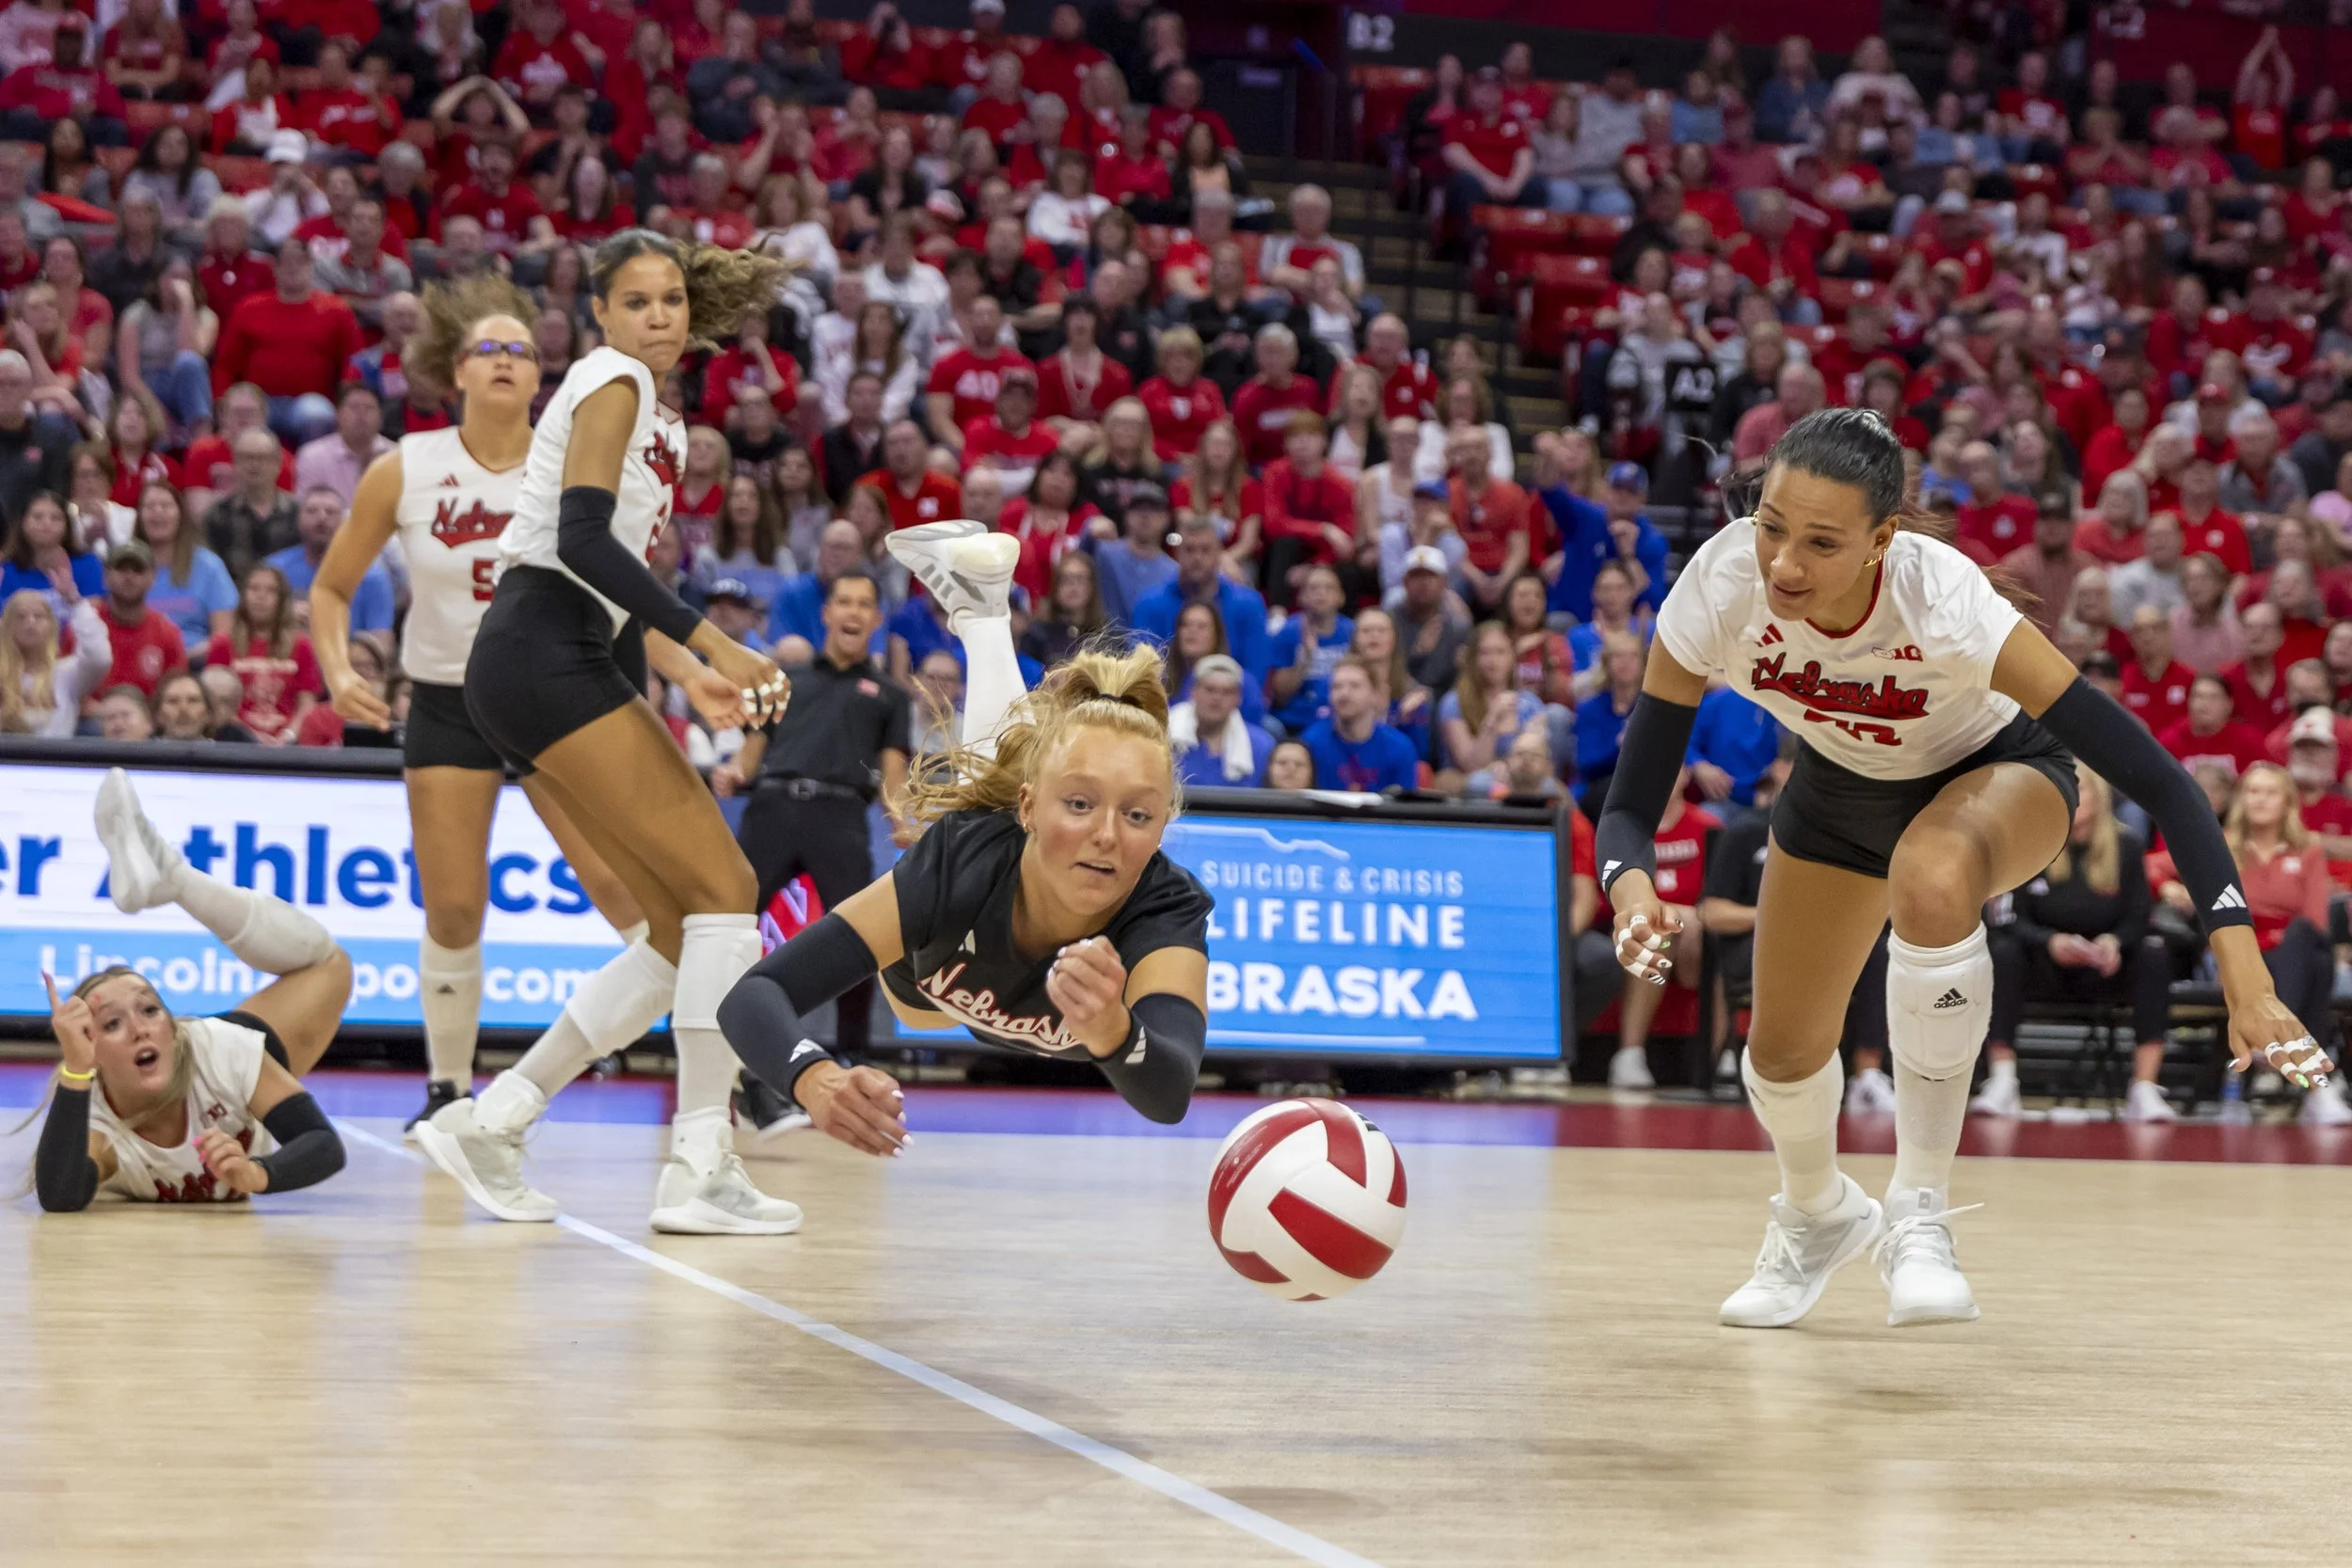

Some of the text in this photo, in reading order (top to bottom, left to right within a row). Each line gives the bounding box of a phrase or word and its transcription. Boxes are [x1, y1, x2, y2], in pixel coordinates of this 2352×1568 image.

[1348, 11, 1394, 51] B2
[1673, 367, 1714, 402] A2
[1752, 652, 1929, 719] Nebraska
[0, 821, 593, 913] r thlecs
[1200, 860, 1464, 897] SUICIDE & CRISIS
[918, 962, 1080, 1049] Nebrask
[1206, 961, 1479, 1022] BRASKA
